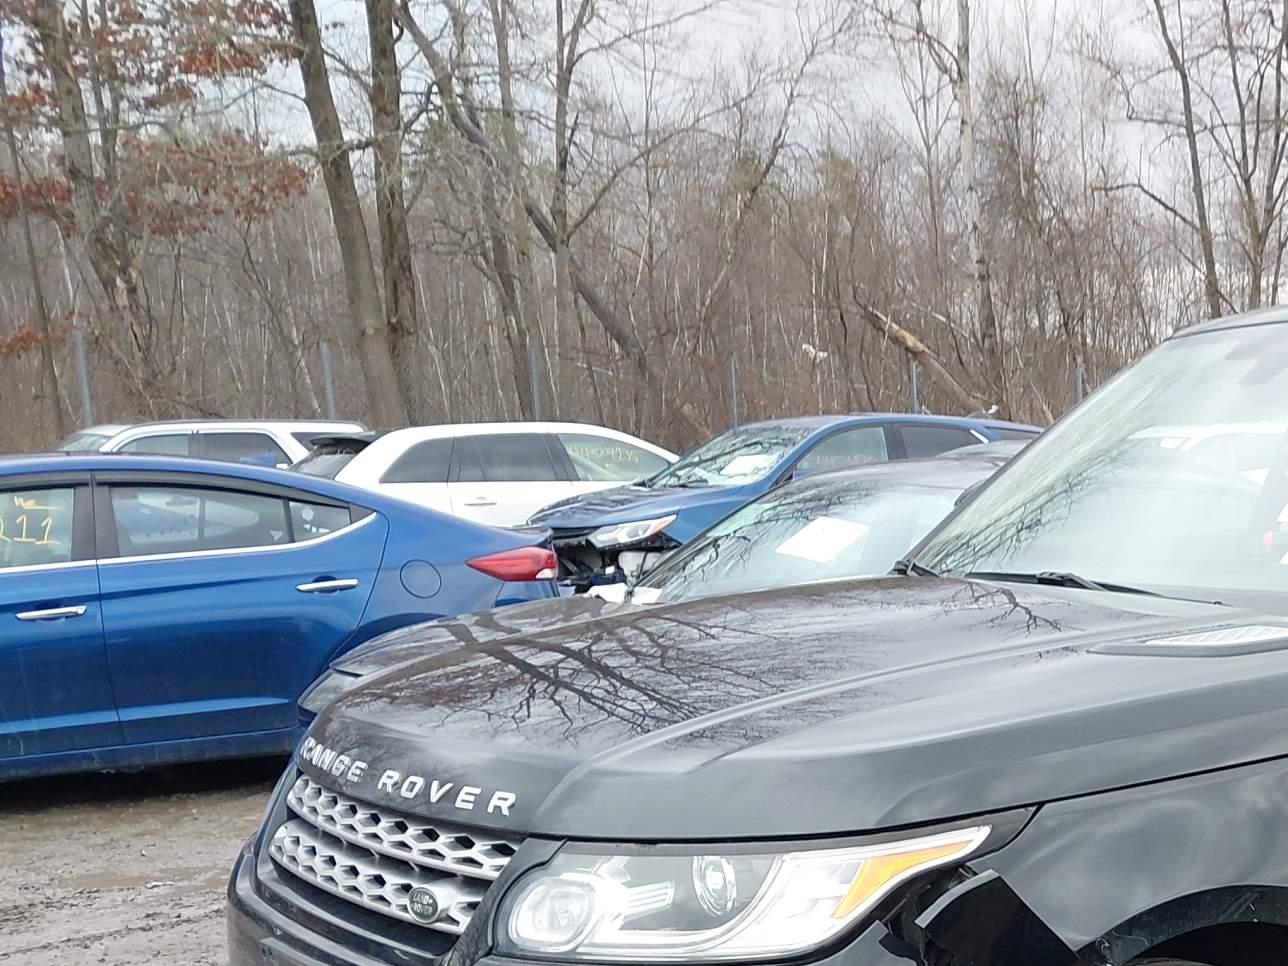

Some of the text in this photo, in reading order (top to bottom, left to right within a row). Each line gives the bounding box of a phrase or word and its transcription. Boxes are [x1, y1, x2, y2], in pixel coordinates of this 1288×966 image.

[300, 736, 516, 817] RANGE ROVER
[412, 892, 429, 905] LAND
[412, 902, 433, 916] ROVER
